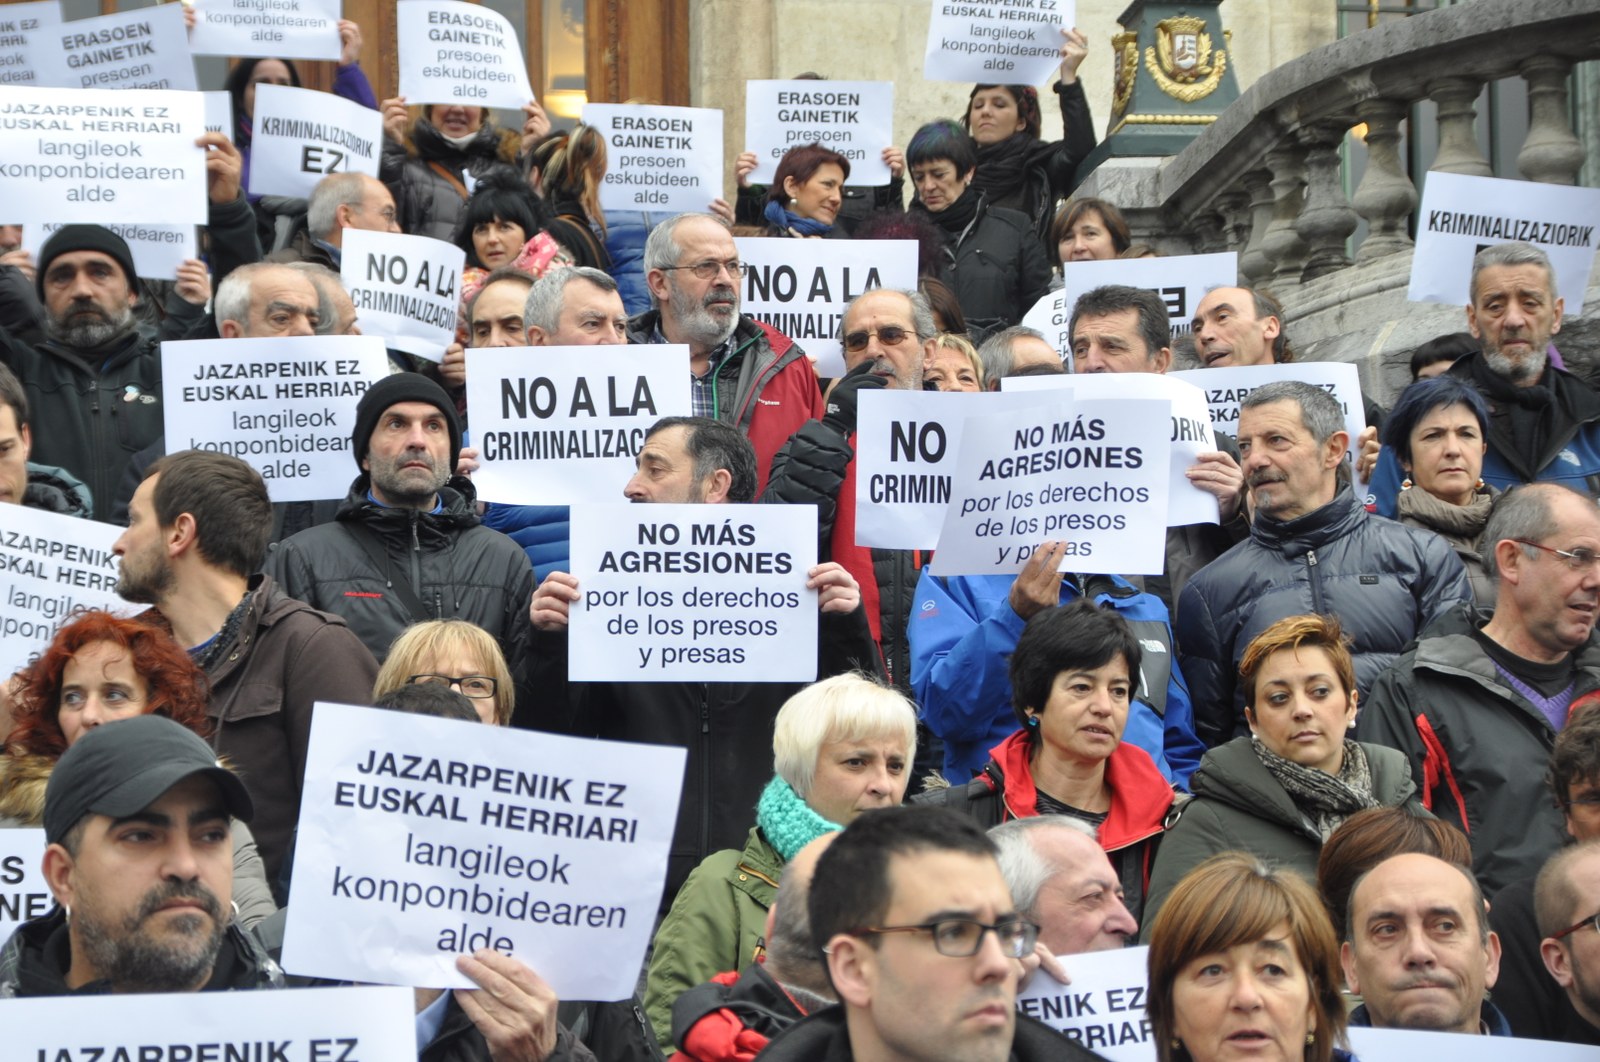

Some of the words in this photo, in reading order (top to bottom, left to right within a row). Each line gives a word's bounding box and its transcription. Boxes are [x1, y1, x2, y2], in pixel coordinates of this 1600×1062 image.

[205, 12, 327, 28] konponbidearen
[428, 11, 503, 35] ERASOEN
[942, 6, 994, 18] EUSKAL
[1000, 10, 1063, 24] HERRIARI
[62, 22, 151, 50] ERASOEN
[251, 30, 284, 42] alde
[428, 29, 505, 49] GAINETIK
[970, 24, 1035, 40] langileok
[67, 41, 155, 68] GAINETIK
[437, 48, 502, 64] presoen
[942, 38, 1060, 58] konponbidearen
[80, 63, 152, 88] presoen
[422, 64, 516, 84] eskubideen
[984, 59, 1014, 70] alde
[453, 83, 488, 98] alde
[778, 92, 860, 106] ERASOEN
[1, 103, 135, 118] JAZARPENIK
[143, 107, 169, 118] EZ
[778, 109, 859, 123] GAINETIK
[0, 119, 74, 130] USKAL
[82, 121, 181, 134] HERRIARI
[612, 116, 693, 133] ERASOEN
[786, 130, 852, 143] presoen
[38, 138, 142, 160] langileok
[261, 116, 373, 159] KRIMINALIZAZIORIK
[612, 134, 692, 150] GAINETIK
[0, 162, 185, 182] konponbidearen
[620, 155, 686, 173] presoen
[605, 172, 700, 187] eskubideen
[66, 185, 116, 202] alde
[634, 190, 670, 204] alde
[1428, 210, 1595, 247] KRIMINALIZAZIORIK
[367, 253, 407, 285] NO
[415, 260, 430, 292] A
[435, 265, 456, 301] LA
[748, 265, 797, 303] NO
[807, 267, 832, 303] A
[193, 360, 328, 381] JAZARPENIK
[335, 359, 361, 376] EZ
[182, 383, 268, 402] EUSKAL
[501, 376, 558, 420] NO
[569, 377, 597, 418] A
[608, 376, 658, 417] LA
[232, 408, 337, 433] langileok
[483, 427, 652, 461] CRIMINALIZAC
[890, 420, 947, 464] NO
[1014, 426, 1044, 451] NO
[1052, 415, 1106, 443] MÁS
[190, 433, 353, 459] konponbidear
[262, 459, 311, 479] alde
[978, 446, 1143, 481] AGRESIONES
[960, 494, 1000, 517] por
[1005, 490, 1033, 511] los
[1039, 481, 1150, 506] derechos
[638, 523, 680, 546] NO
[691, 519, 756, 546] MÁS
[975, 518, 1004, 537] de
[1010, 516, 1038, 536] los
[1044, 510, 1126, 536] presos
[0, 531, 116, 570] ZARPENIK
[598, 551, 793, 574] AGRESIONES
[995, 546, 1011, 565] y
[1015, 540, 1093, 564] pras
[0, 553, 48, 580] SKAL
[56, 566, 118, 593] HERR
[586, 590, 629, 611] por
[637, 586, 673, 608] los
[682, 587, 799, 608] derechos
[607, 615, 639, 635] de
[648, 615, 684, 635] los
[693, 619, 778, 640] presos
[639, 648, 652, 668] y
[661, 647, 746, 668] presas
[357, 750, 574, 801] JAZARPENIK
[584, 781, 627, 808] EZ
[334, 782, 468, 822] EUSKAL
[480, 802, 638, 843] HERRIARI
[404, 833, 571, 885] langileok
[332, 866, 627, 929] konponbidearen
[436, 924, 514, 957] alde
[1106, 986, 1147, 1013] EZ
[309, 1038, 359, 1062] EZ
